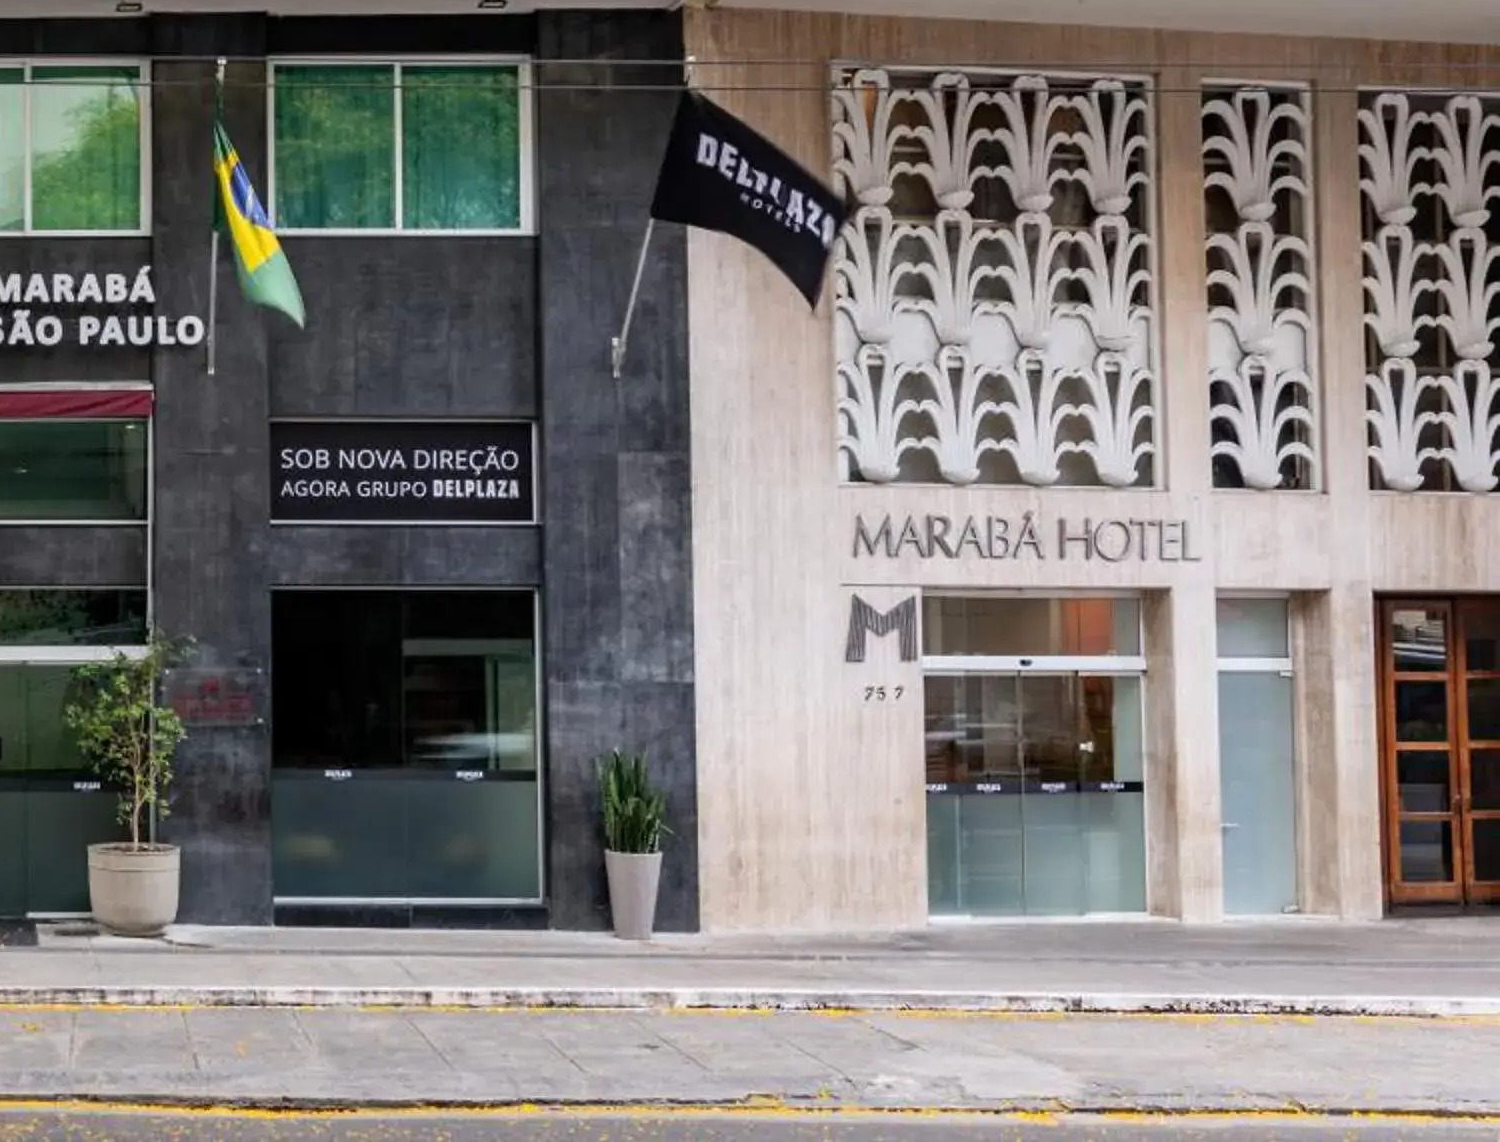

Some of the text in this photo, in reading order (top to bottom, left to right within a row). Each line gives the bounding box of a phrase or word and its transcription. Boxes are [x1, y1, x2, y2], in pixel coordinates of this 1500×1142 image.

[78, 314, 205, 346] PAULO
[280, 445, 519, 475] SOB NOVA DIREÇÃO
[280, 479, 520, 499] AGORA GRUPO DELPLAZA
[853, 510, 1203, 562] MARABÁ HOTEL
[845, 593, 918, 663] M
[864, 685, 905, 701] 757
